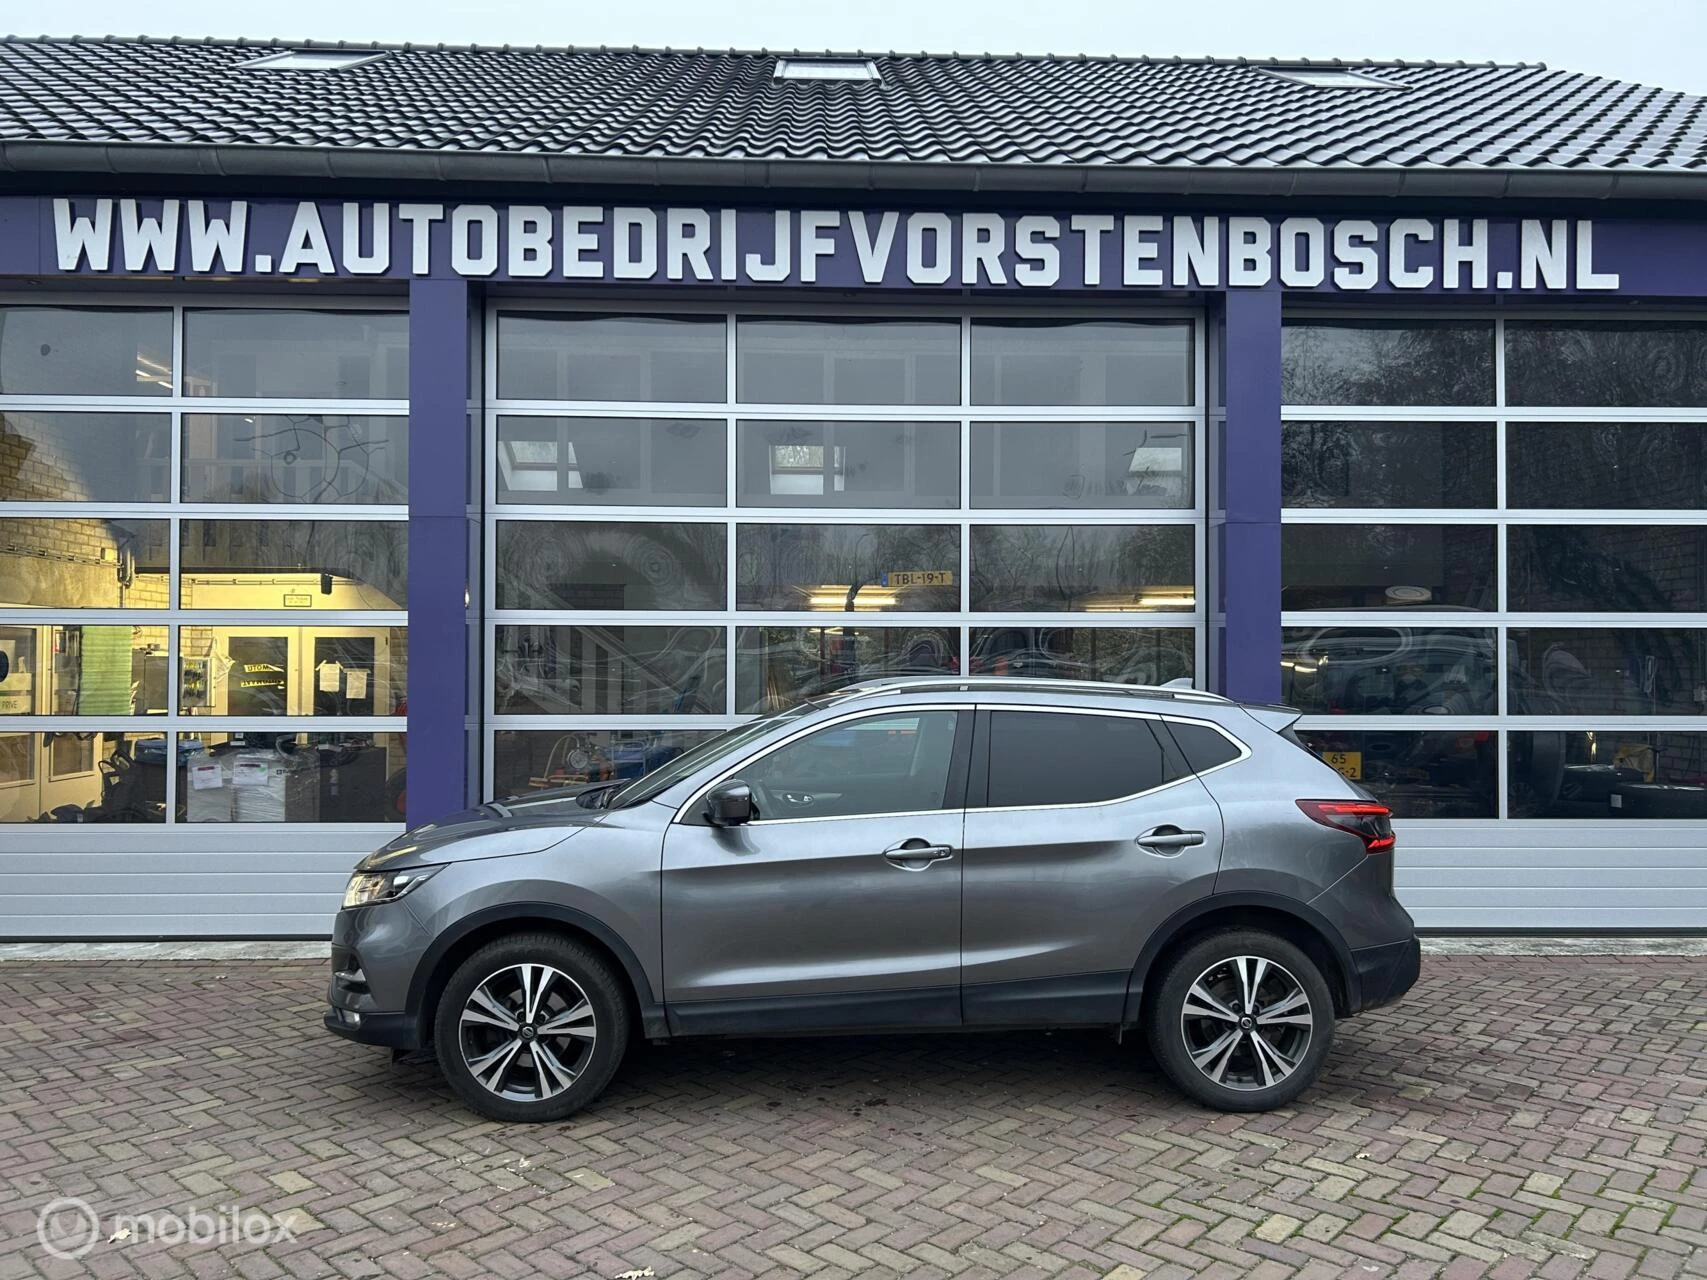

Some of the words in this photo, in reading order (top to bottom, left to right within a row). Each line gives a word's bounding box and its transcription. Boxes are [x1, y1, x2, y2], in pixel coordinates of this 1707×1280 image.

[53, 197, 1620, 291] WWW.AUTOBEDRIJFVORSTENBOSCH.NL
[895, 572, 946, 585] TBL-19-T
[1331, 753, 1346, 764] 65
